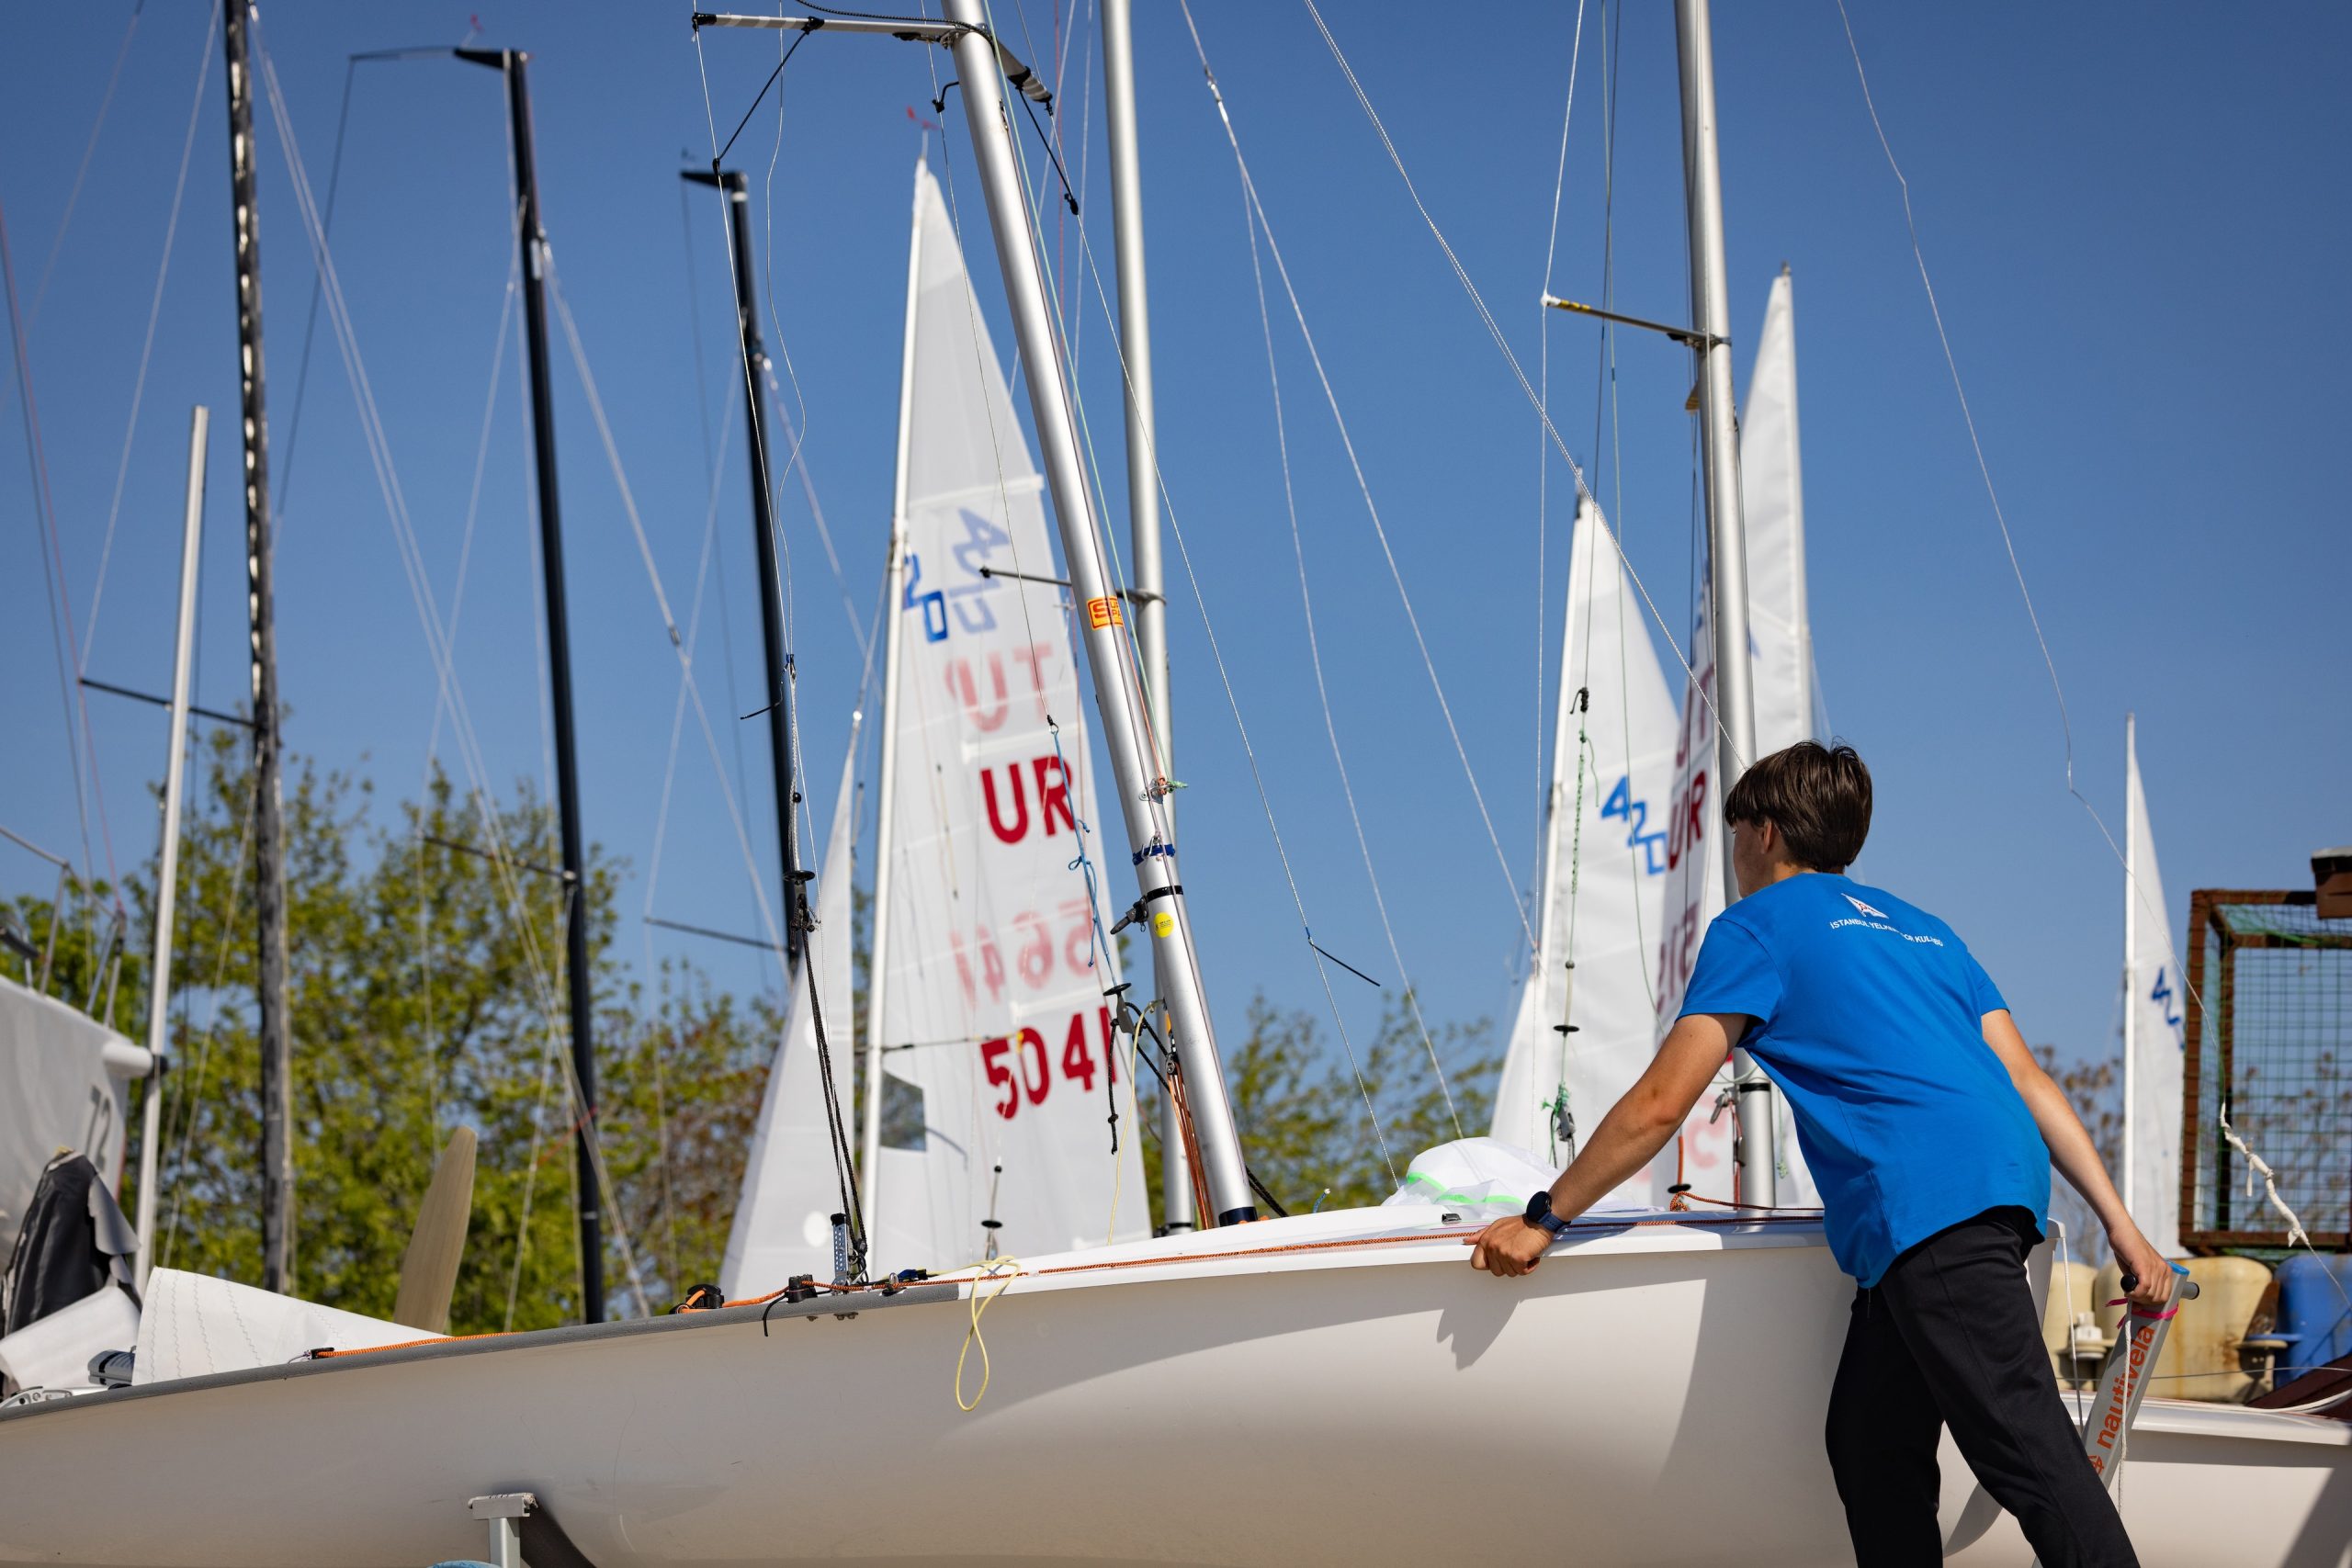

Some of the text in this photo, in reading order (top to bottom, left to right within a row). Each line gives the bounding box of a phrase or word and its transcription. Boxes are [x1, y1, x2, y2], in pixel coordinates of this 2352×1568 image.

[980, 756, 1077, 845] UR
[980, 1006, 1116, 1120] 5041
[2097, 1325, 2155, 1450] nautivela
